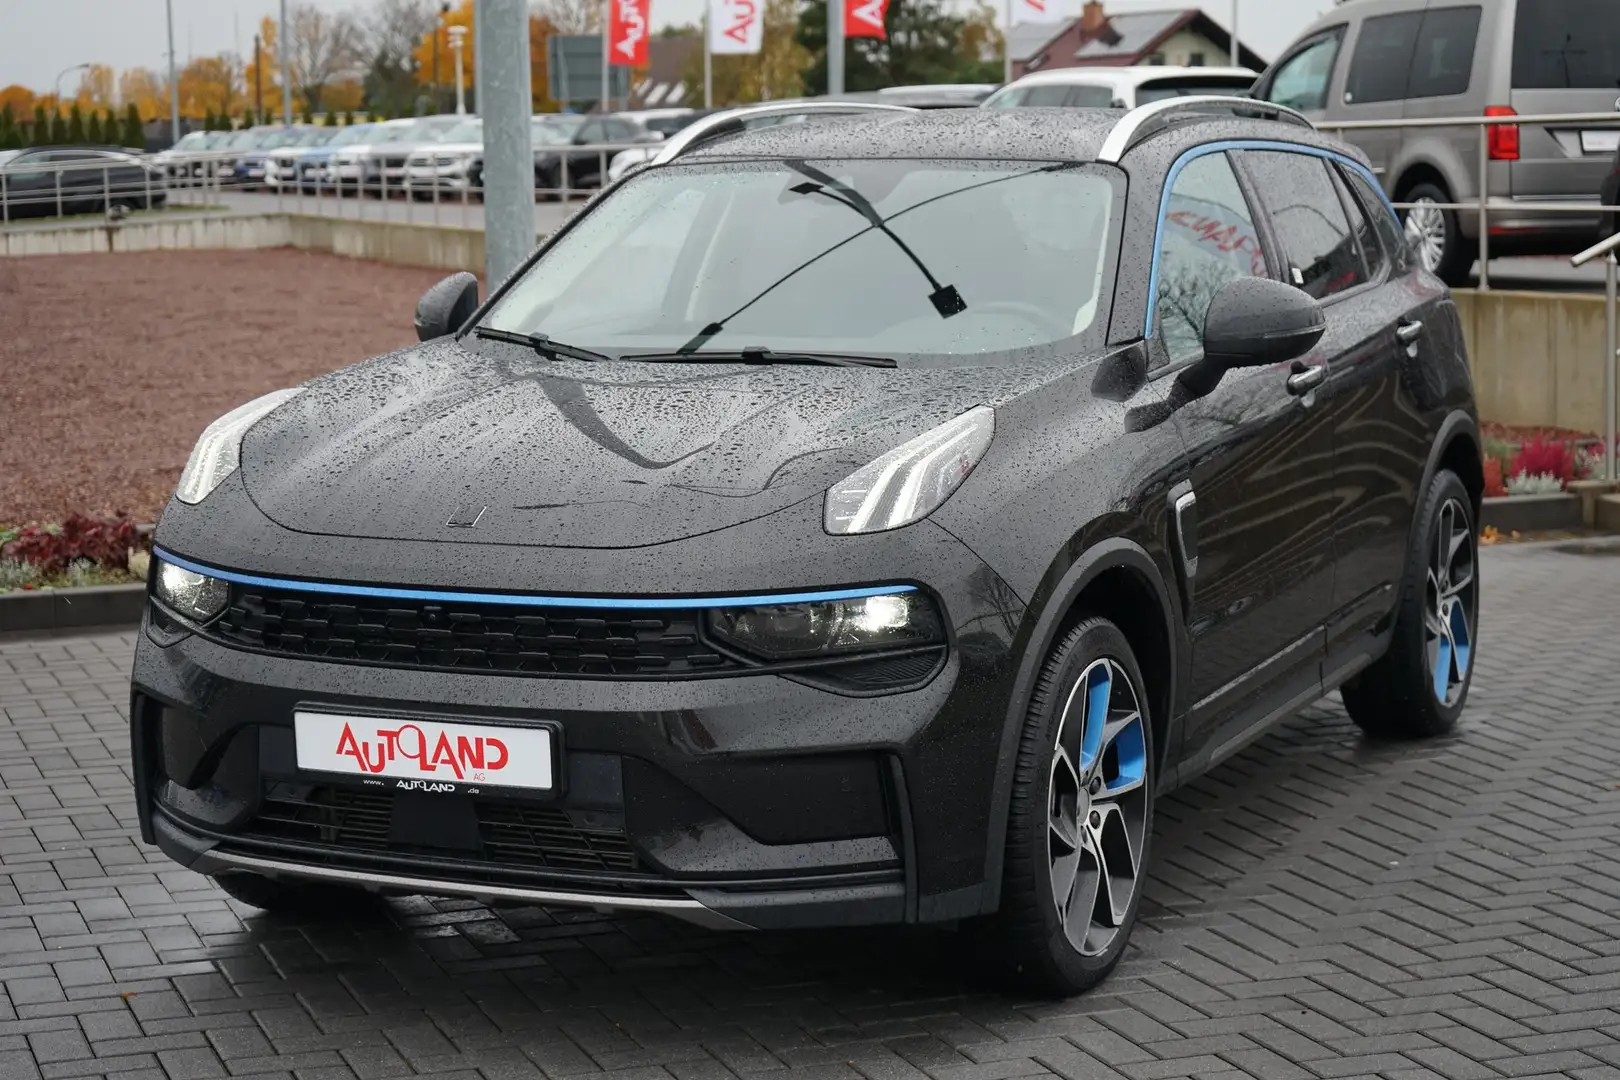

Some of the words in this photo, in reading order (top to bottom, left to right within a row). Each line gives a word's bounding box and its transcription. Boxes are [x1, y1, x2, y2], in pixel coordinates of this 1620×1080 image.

[336, 721, 509, 780] AUTOLAND
[473, 772, 486, 782] AG
[396, 780, 456, 793] AUTOLAND
